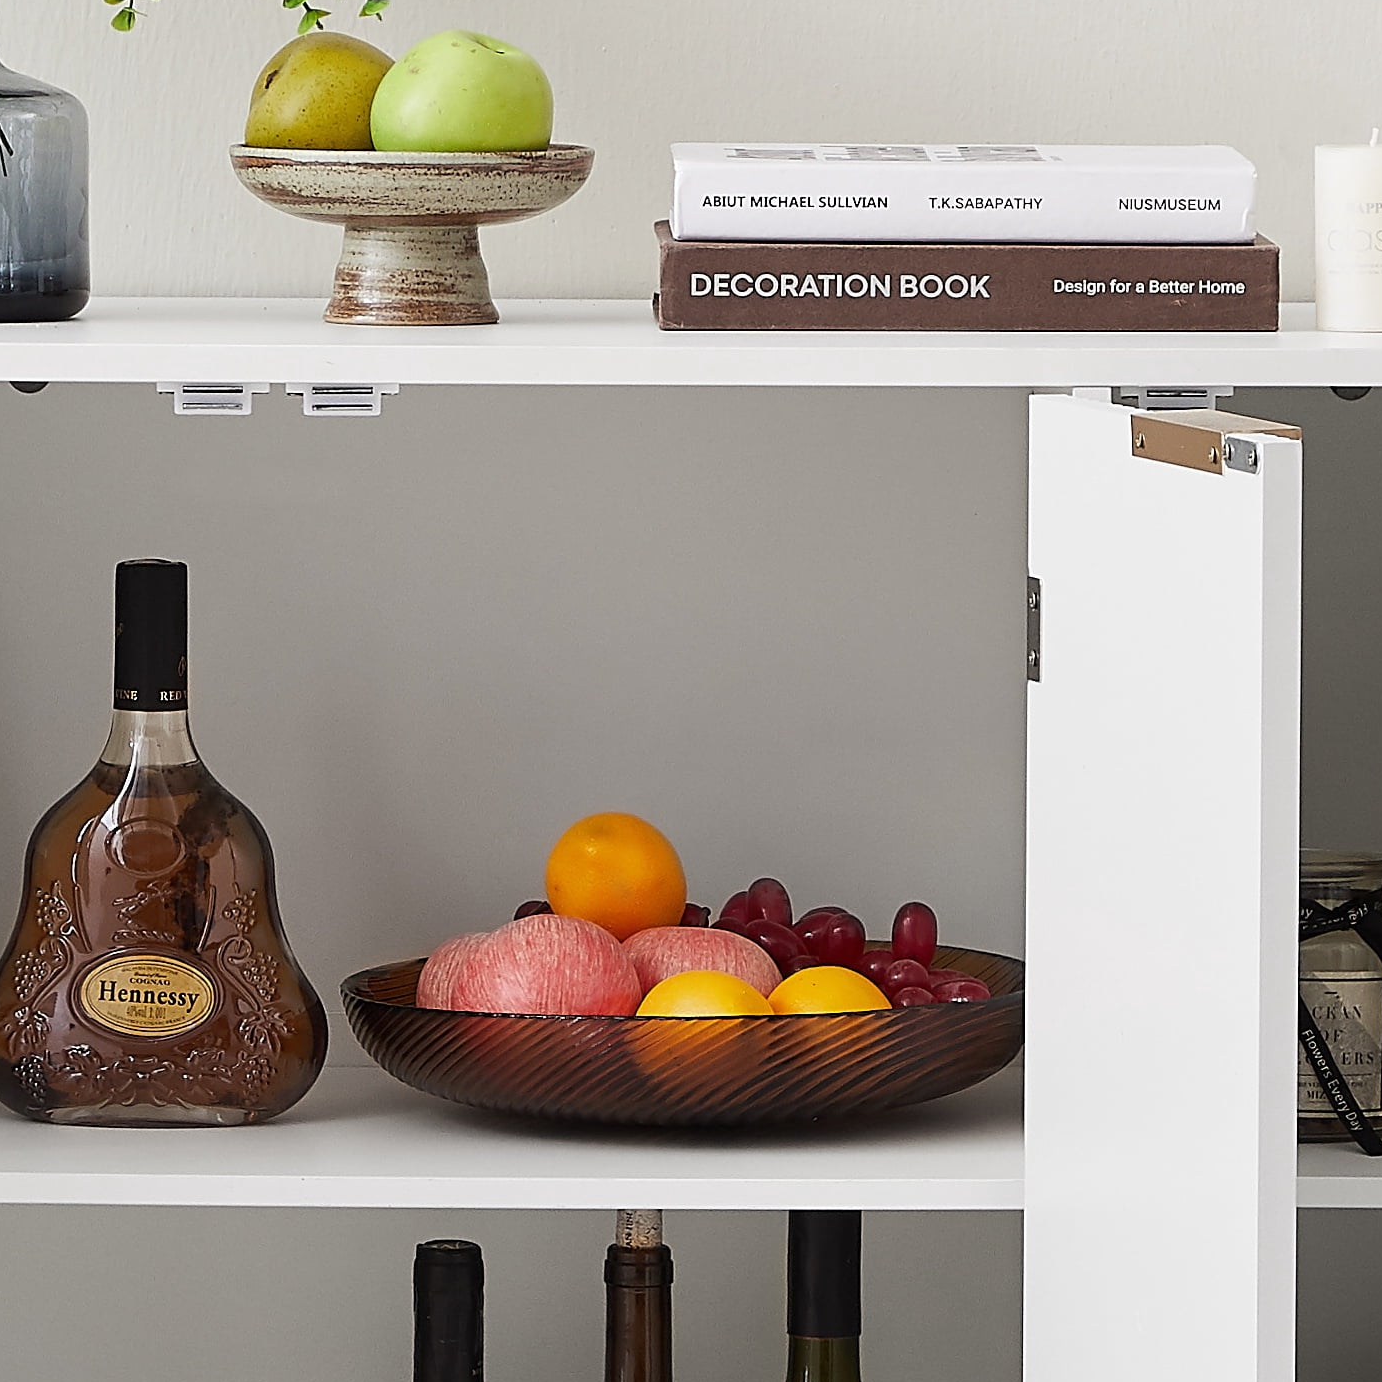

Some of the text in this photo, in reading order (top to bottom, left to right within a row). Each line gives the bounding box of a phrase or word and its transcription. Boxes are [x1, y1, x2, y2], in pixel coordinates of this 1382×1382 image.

[702, 195, 888, 208] ABIUT MICHAEL SULLVIAN
[929, 197, 1043, 210] T.K.SABAPATHY
[1119, 198, 1221, 211] NIUSMUSEUM
[690, 273, 991, 298] DECORATION BOOK
[1053, 279, 1246, 296] Design for a Better Home
[160, 690, 182, 701] RED
[129, 977, 171, 986] COGNAC
[98, 980, 200, 1013] Hennessy
[1301, 1029, 1332, 1079] Flowers
[1327, 1078, 1350, 1112] Every
[1345, 1111, 1364, 1131] Day
